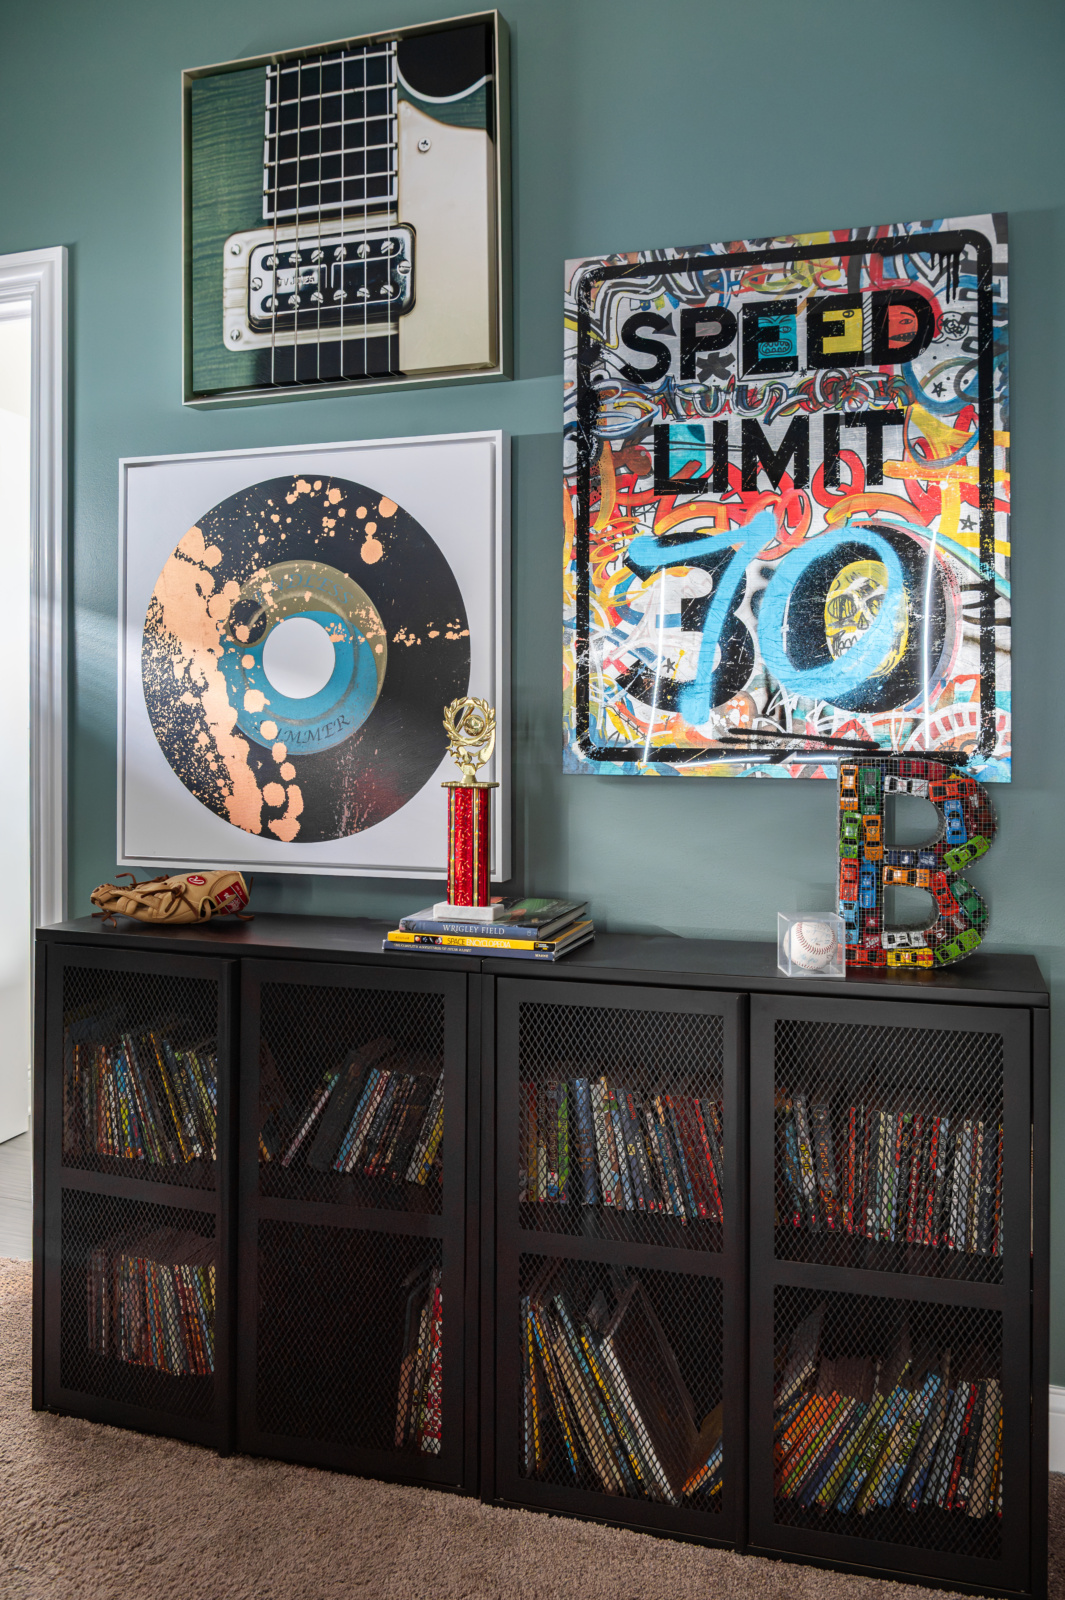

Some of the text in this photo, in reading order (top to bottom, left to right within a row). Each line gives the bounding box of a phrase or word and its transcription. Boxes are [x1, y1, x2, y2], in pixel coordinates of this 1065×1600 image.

[620, 289, 936, 384] SPEED
[653, 408, 905, 496] LIMIT
[253, 714, 351, 744] MMER
[442, 924, 505, 935] WRIGLEY FIELD
[447, 937, 512, 948] SPACE ENCYCLOPEDIA
